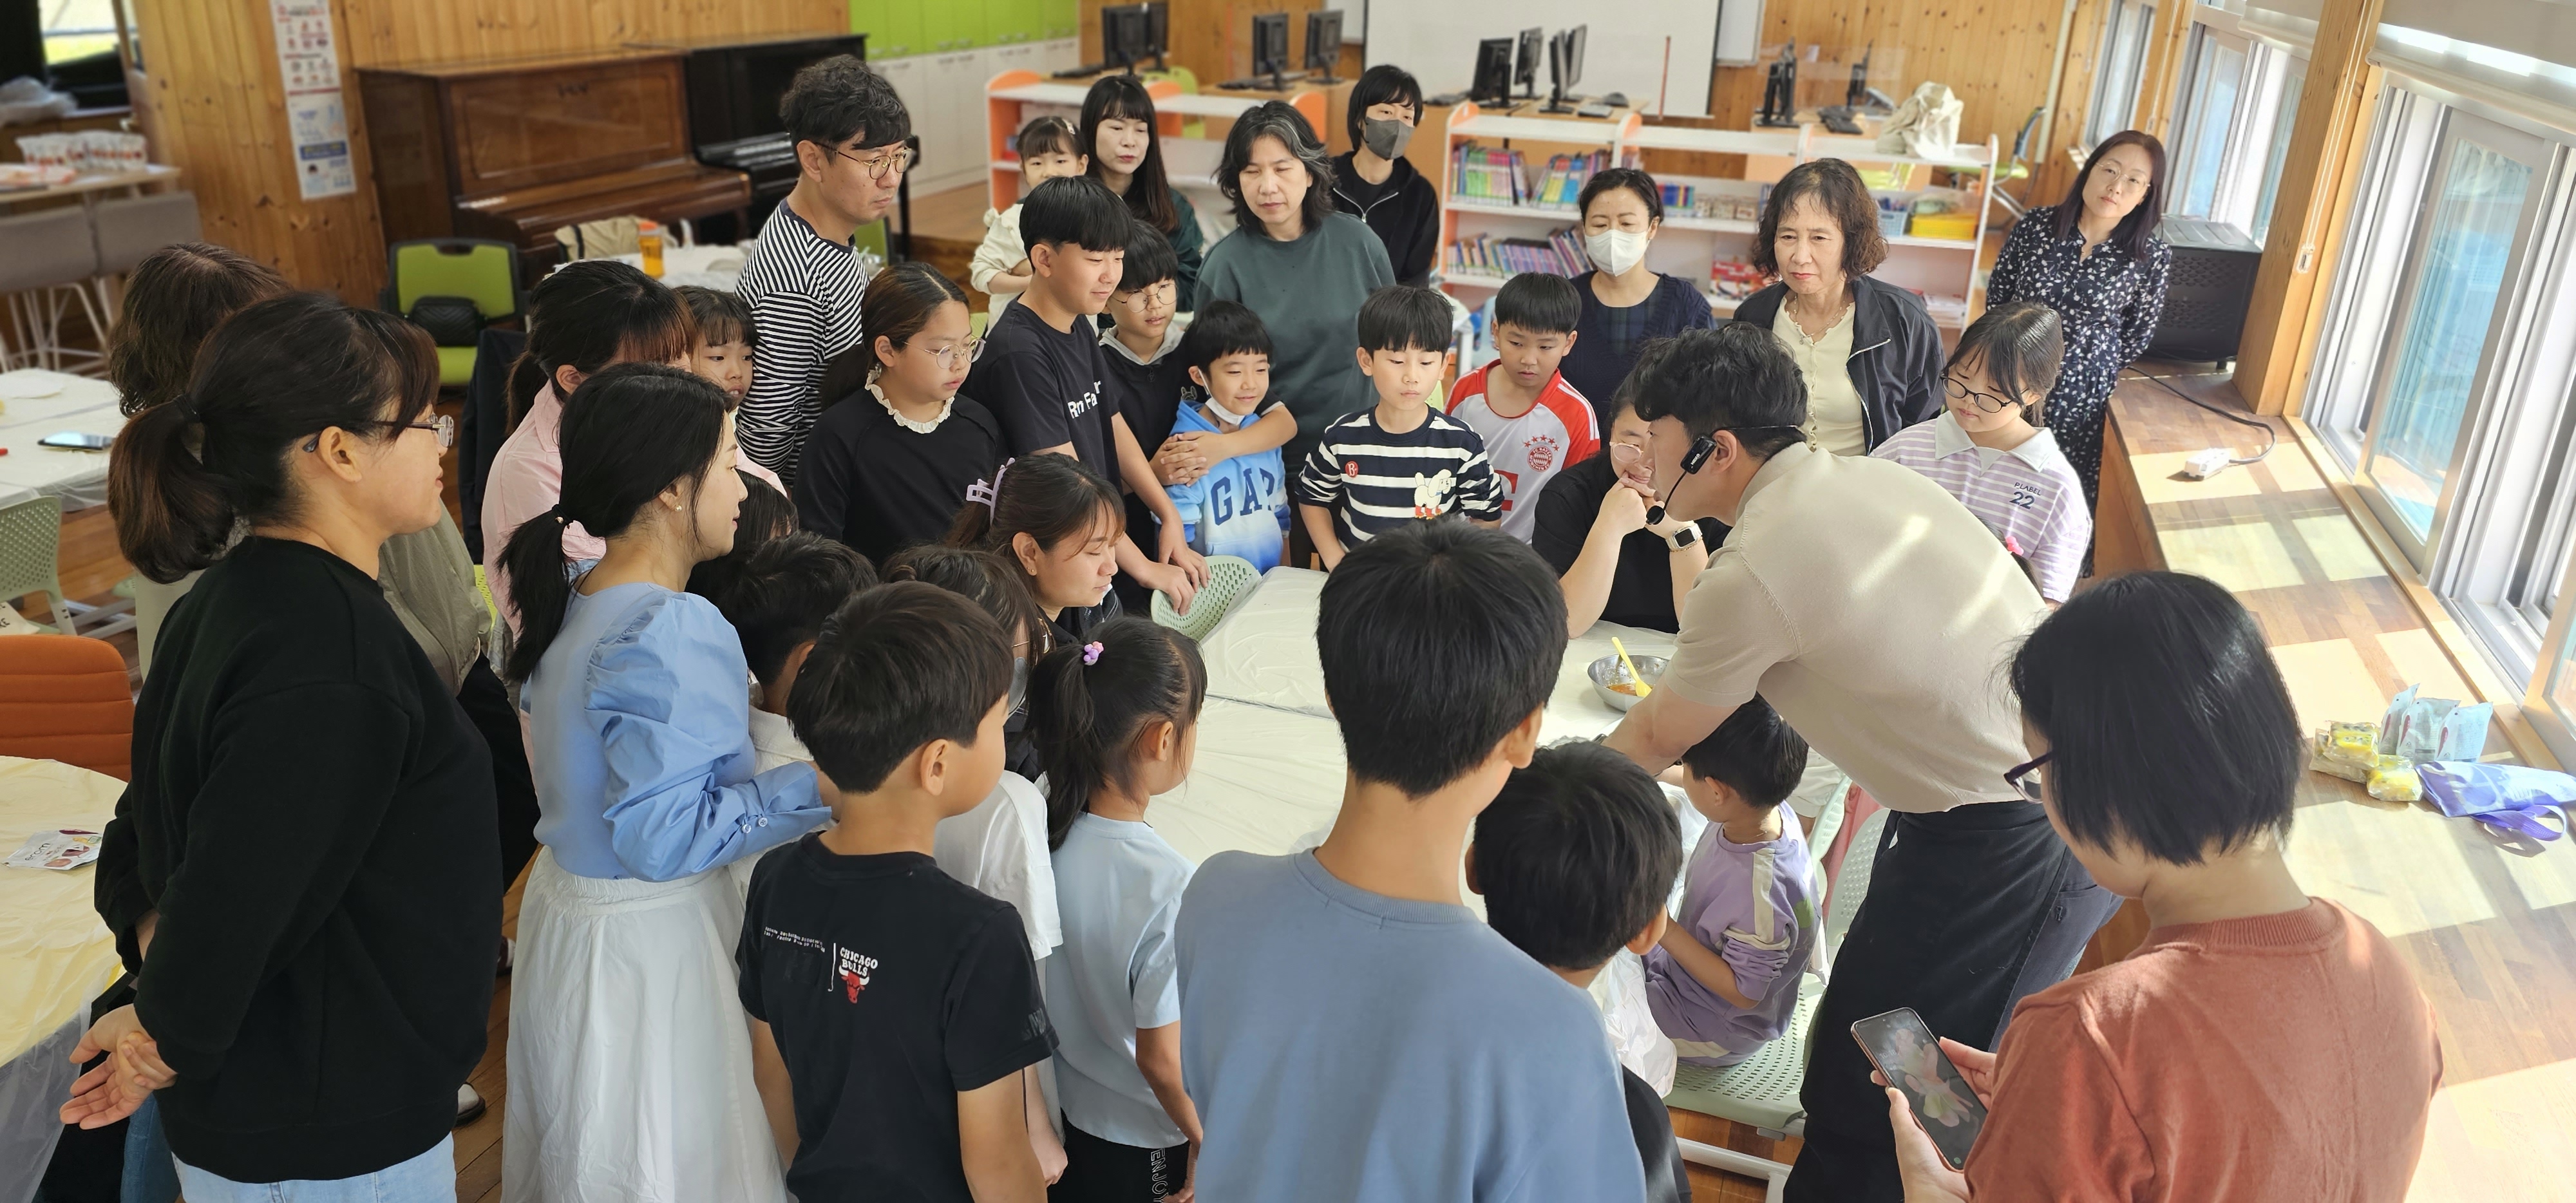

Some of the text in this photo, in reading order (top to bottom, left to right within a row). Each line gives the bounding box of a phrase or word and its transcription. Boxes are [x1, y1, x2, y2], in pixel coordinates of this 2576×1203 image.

[1083, 380, 1101, 410] Far
[1211, 468, 1275, 526] GAP
[2009, 491, 2035, 509] 22
[25, 843, 51, 861] erom
[840, 947, 878, 969] CHICAGO
[842, 958, 868, 977] BULLS
[1151, 1148, 1170, 1203] ENJOY
